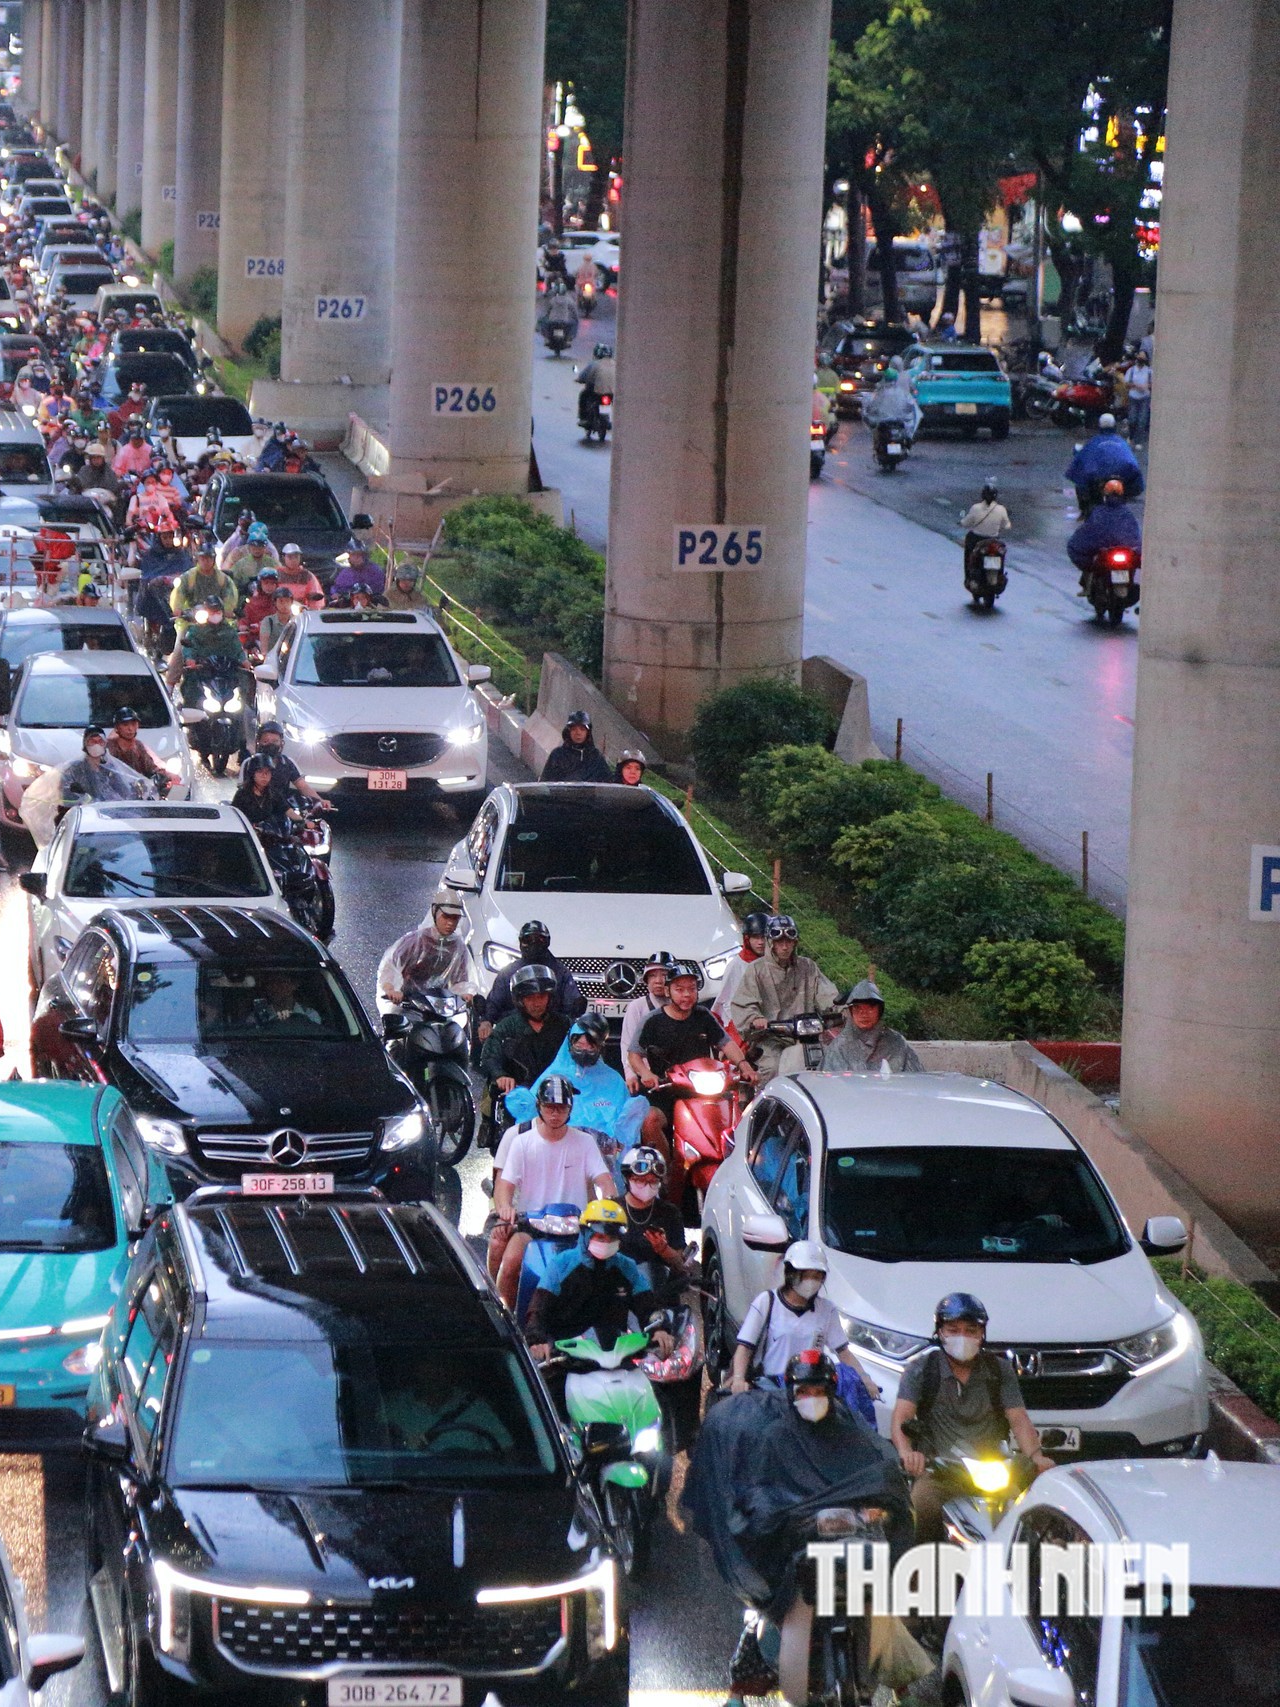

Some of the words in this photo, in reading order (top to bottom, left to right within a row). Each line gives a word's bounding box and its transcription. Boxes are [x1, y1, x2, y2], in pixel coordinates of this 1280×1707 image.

[163, 187, 176, 200] P2
[198, 214, 220, 229] P26
[247, 259, 285, 275] P268
[317, 299, 364, 319] P267
[435, 387, 496, 412] P266
[678, 530, 763, 566] P265
[380, 771, 396, 780] 30H
